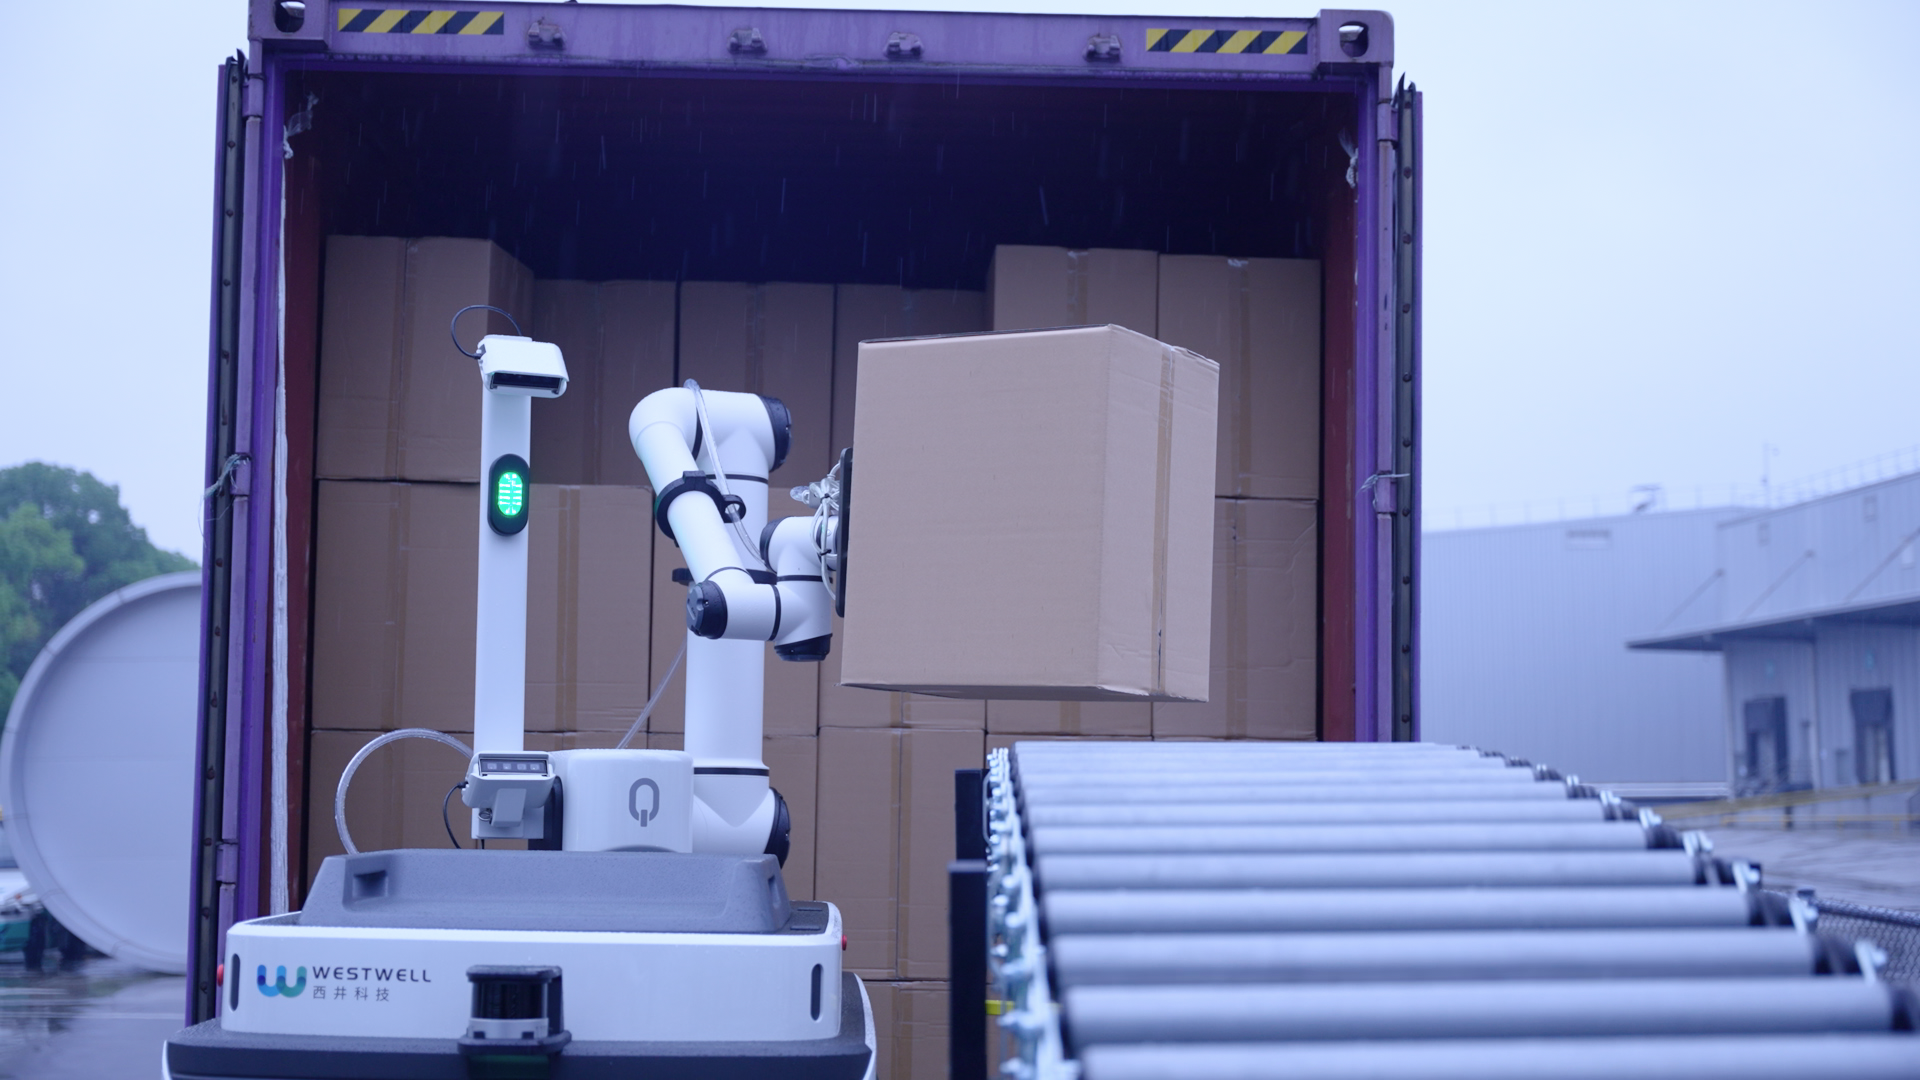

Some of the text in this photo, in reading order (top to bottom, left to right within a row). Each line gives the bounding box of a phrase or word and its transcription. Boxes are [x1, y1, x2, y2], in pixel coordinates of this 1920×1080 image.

[312, 966, 432, 983] WESTWELL
[312, 985, 390, 1002] 西井科技
